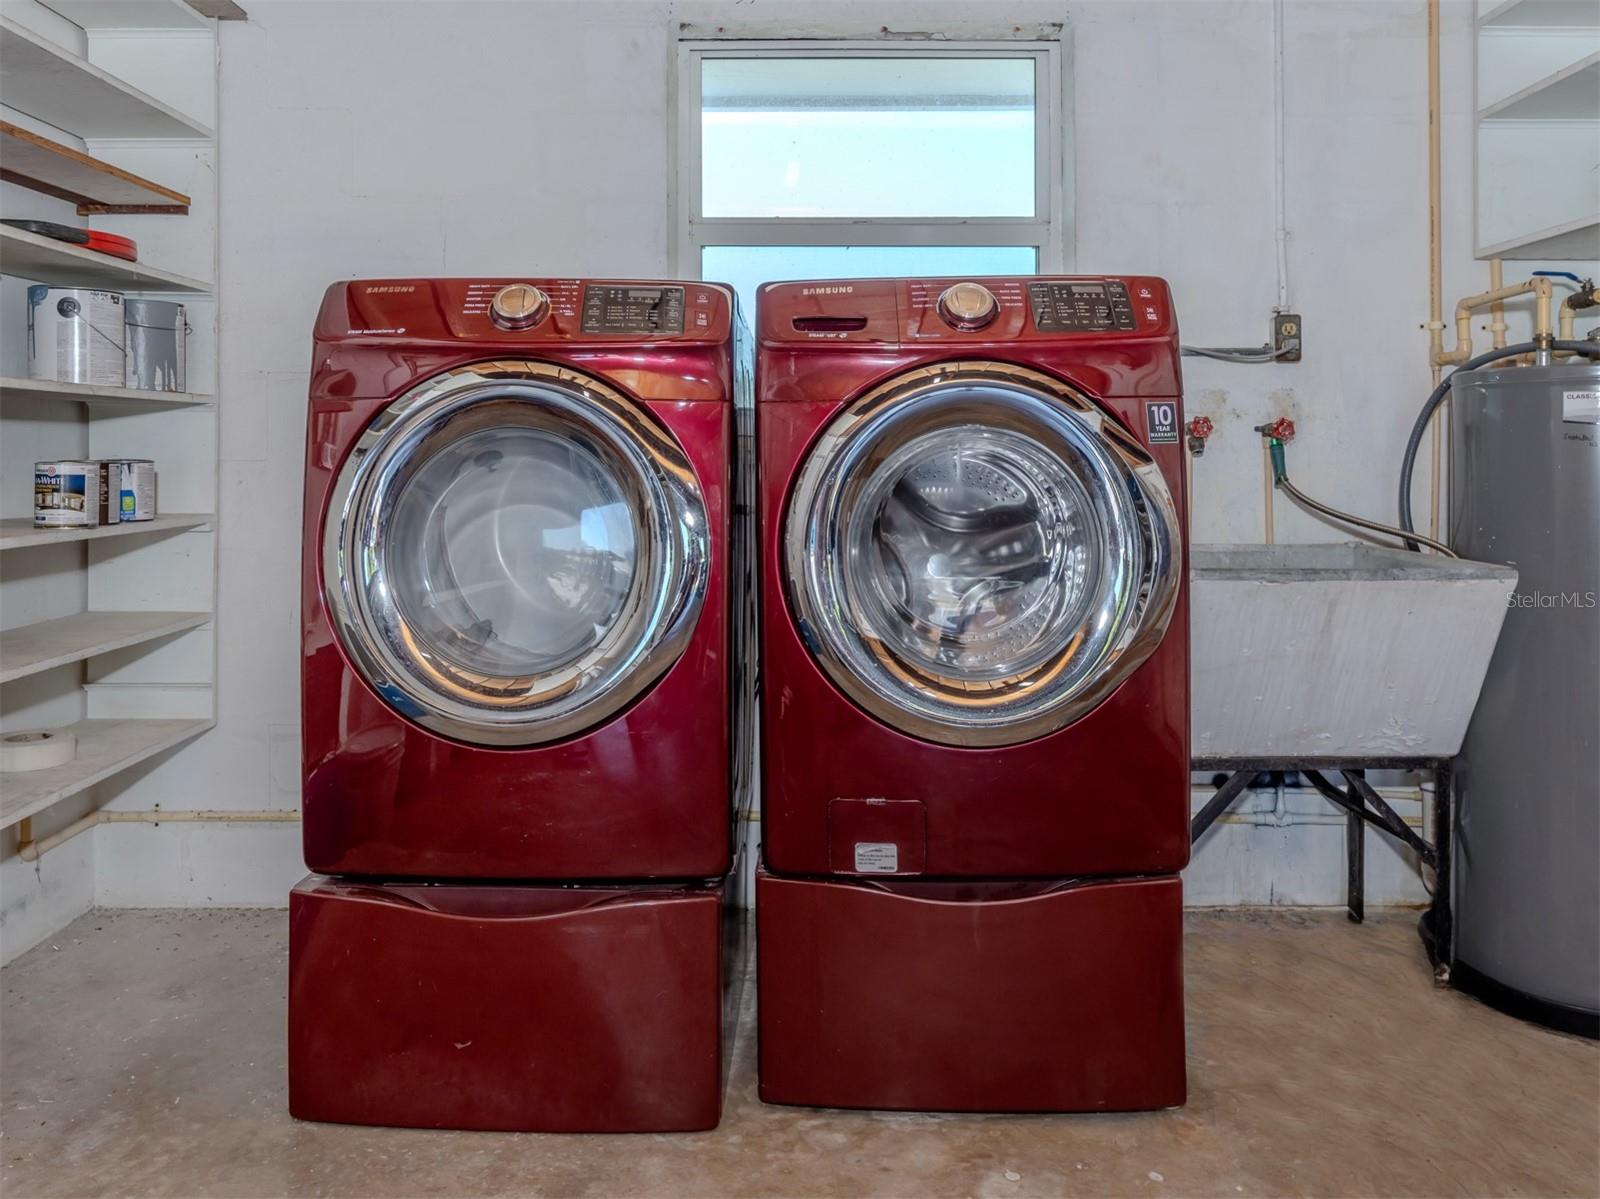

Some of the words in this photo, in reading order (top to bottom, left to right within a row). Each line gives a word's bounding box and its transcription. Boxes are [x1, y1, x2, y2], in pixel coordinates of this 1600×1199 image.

[366, 286, 416, 294] SAMSUNG
[803, 286, 853, 295] SAMSUNG
[1151, 405, 1172, 425] 10
